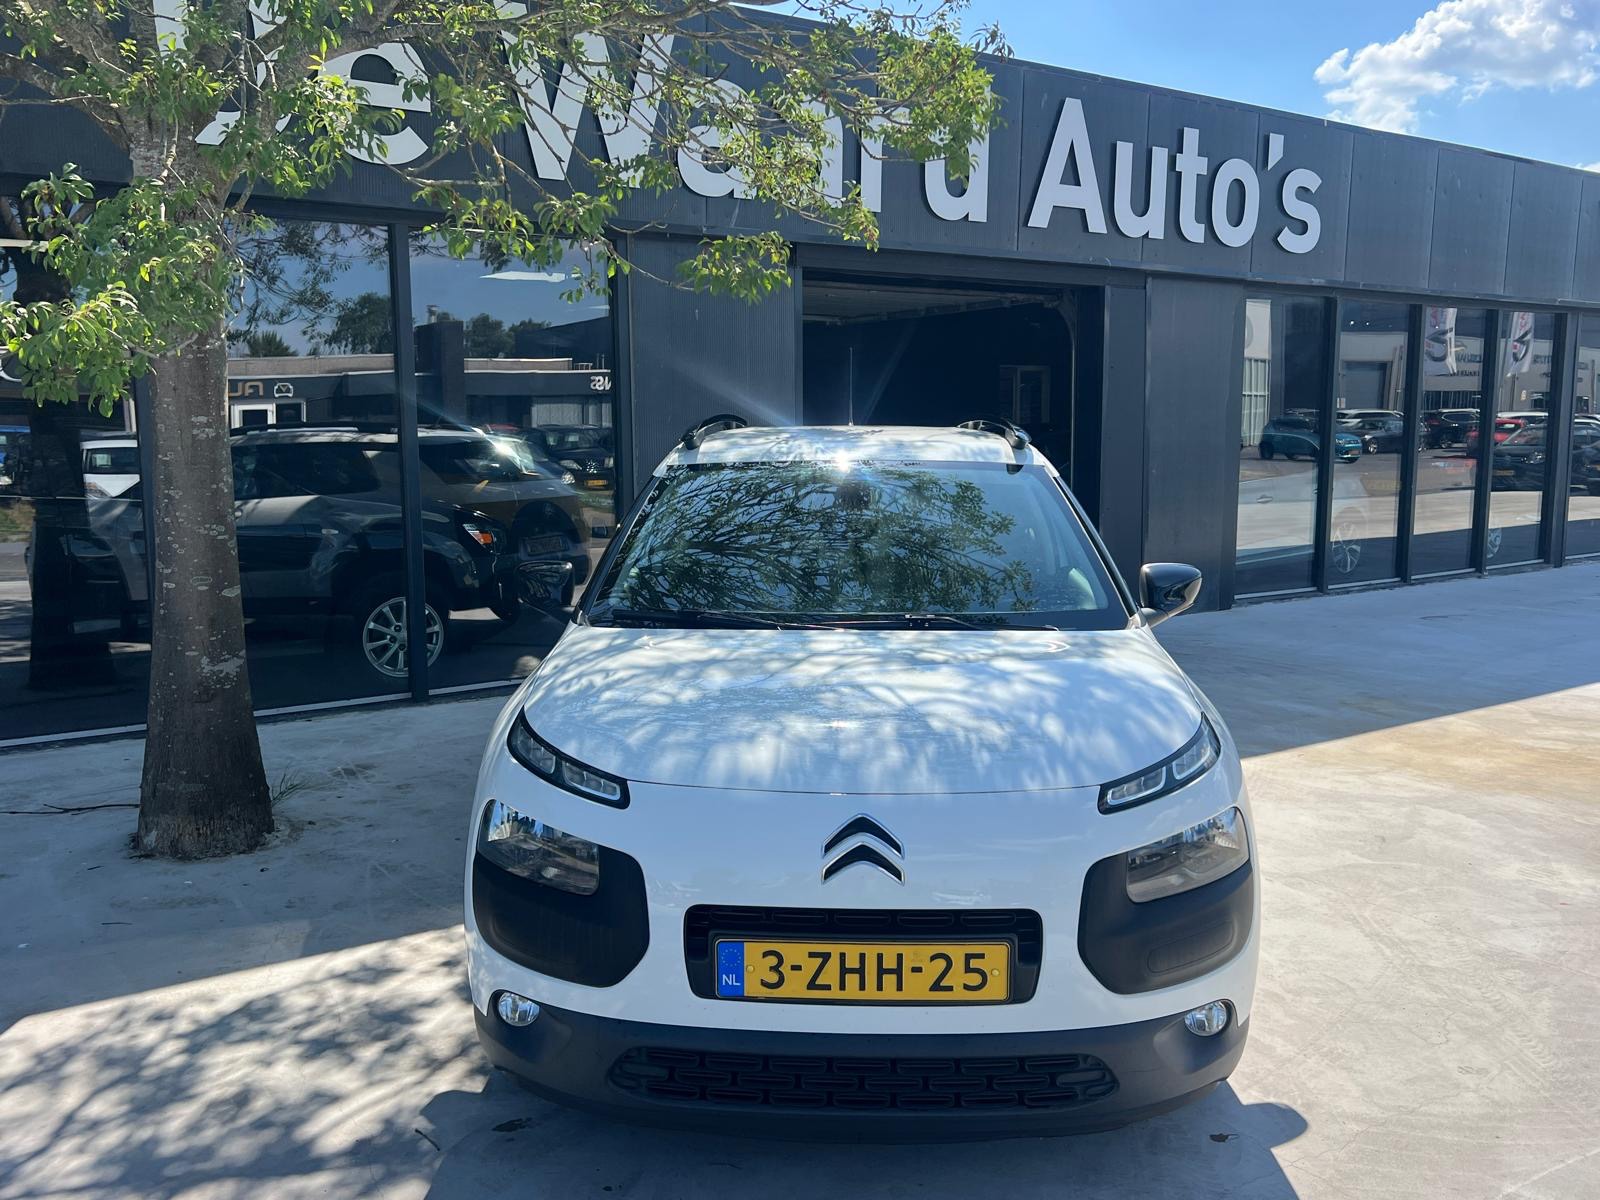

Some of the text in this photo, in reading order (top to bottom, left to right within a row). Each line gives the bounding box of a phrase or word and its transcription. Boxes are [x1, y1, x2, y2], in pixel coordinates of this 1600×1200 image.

[1027, 97, 1322, 254] Auto's
[722, 950, 988, 992] NL 3-ZHH-25
